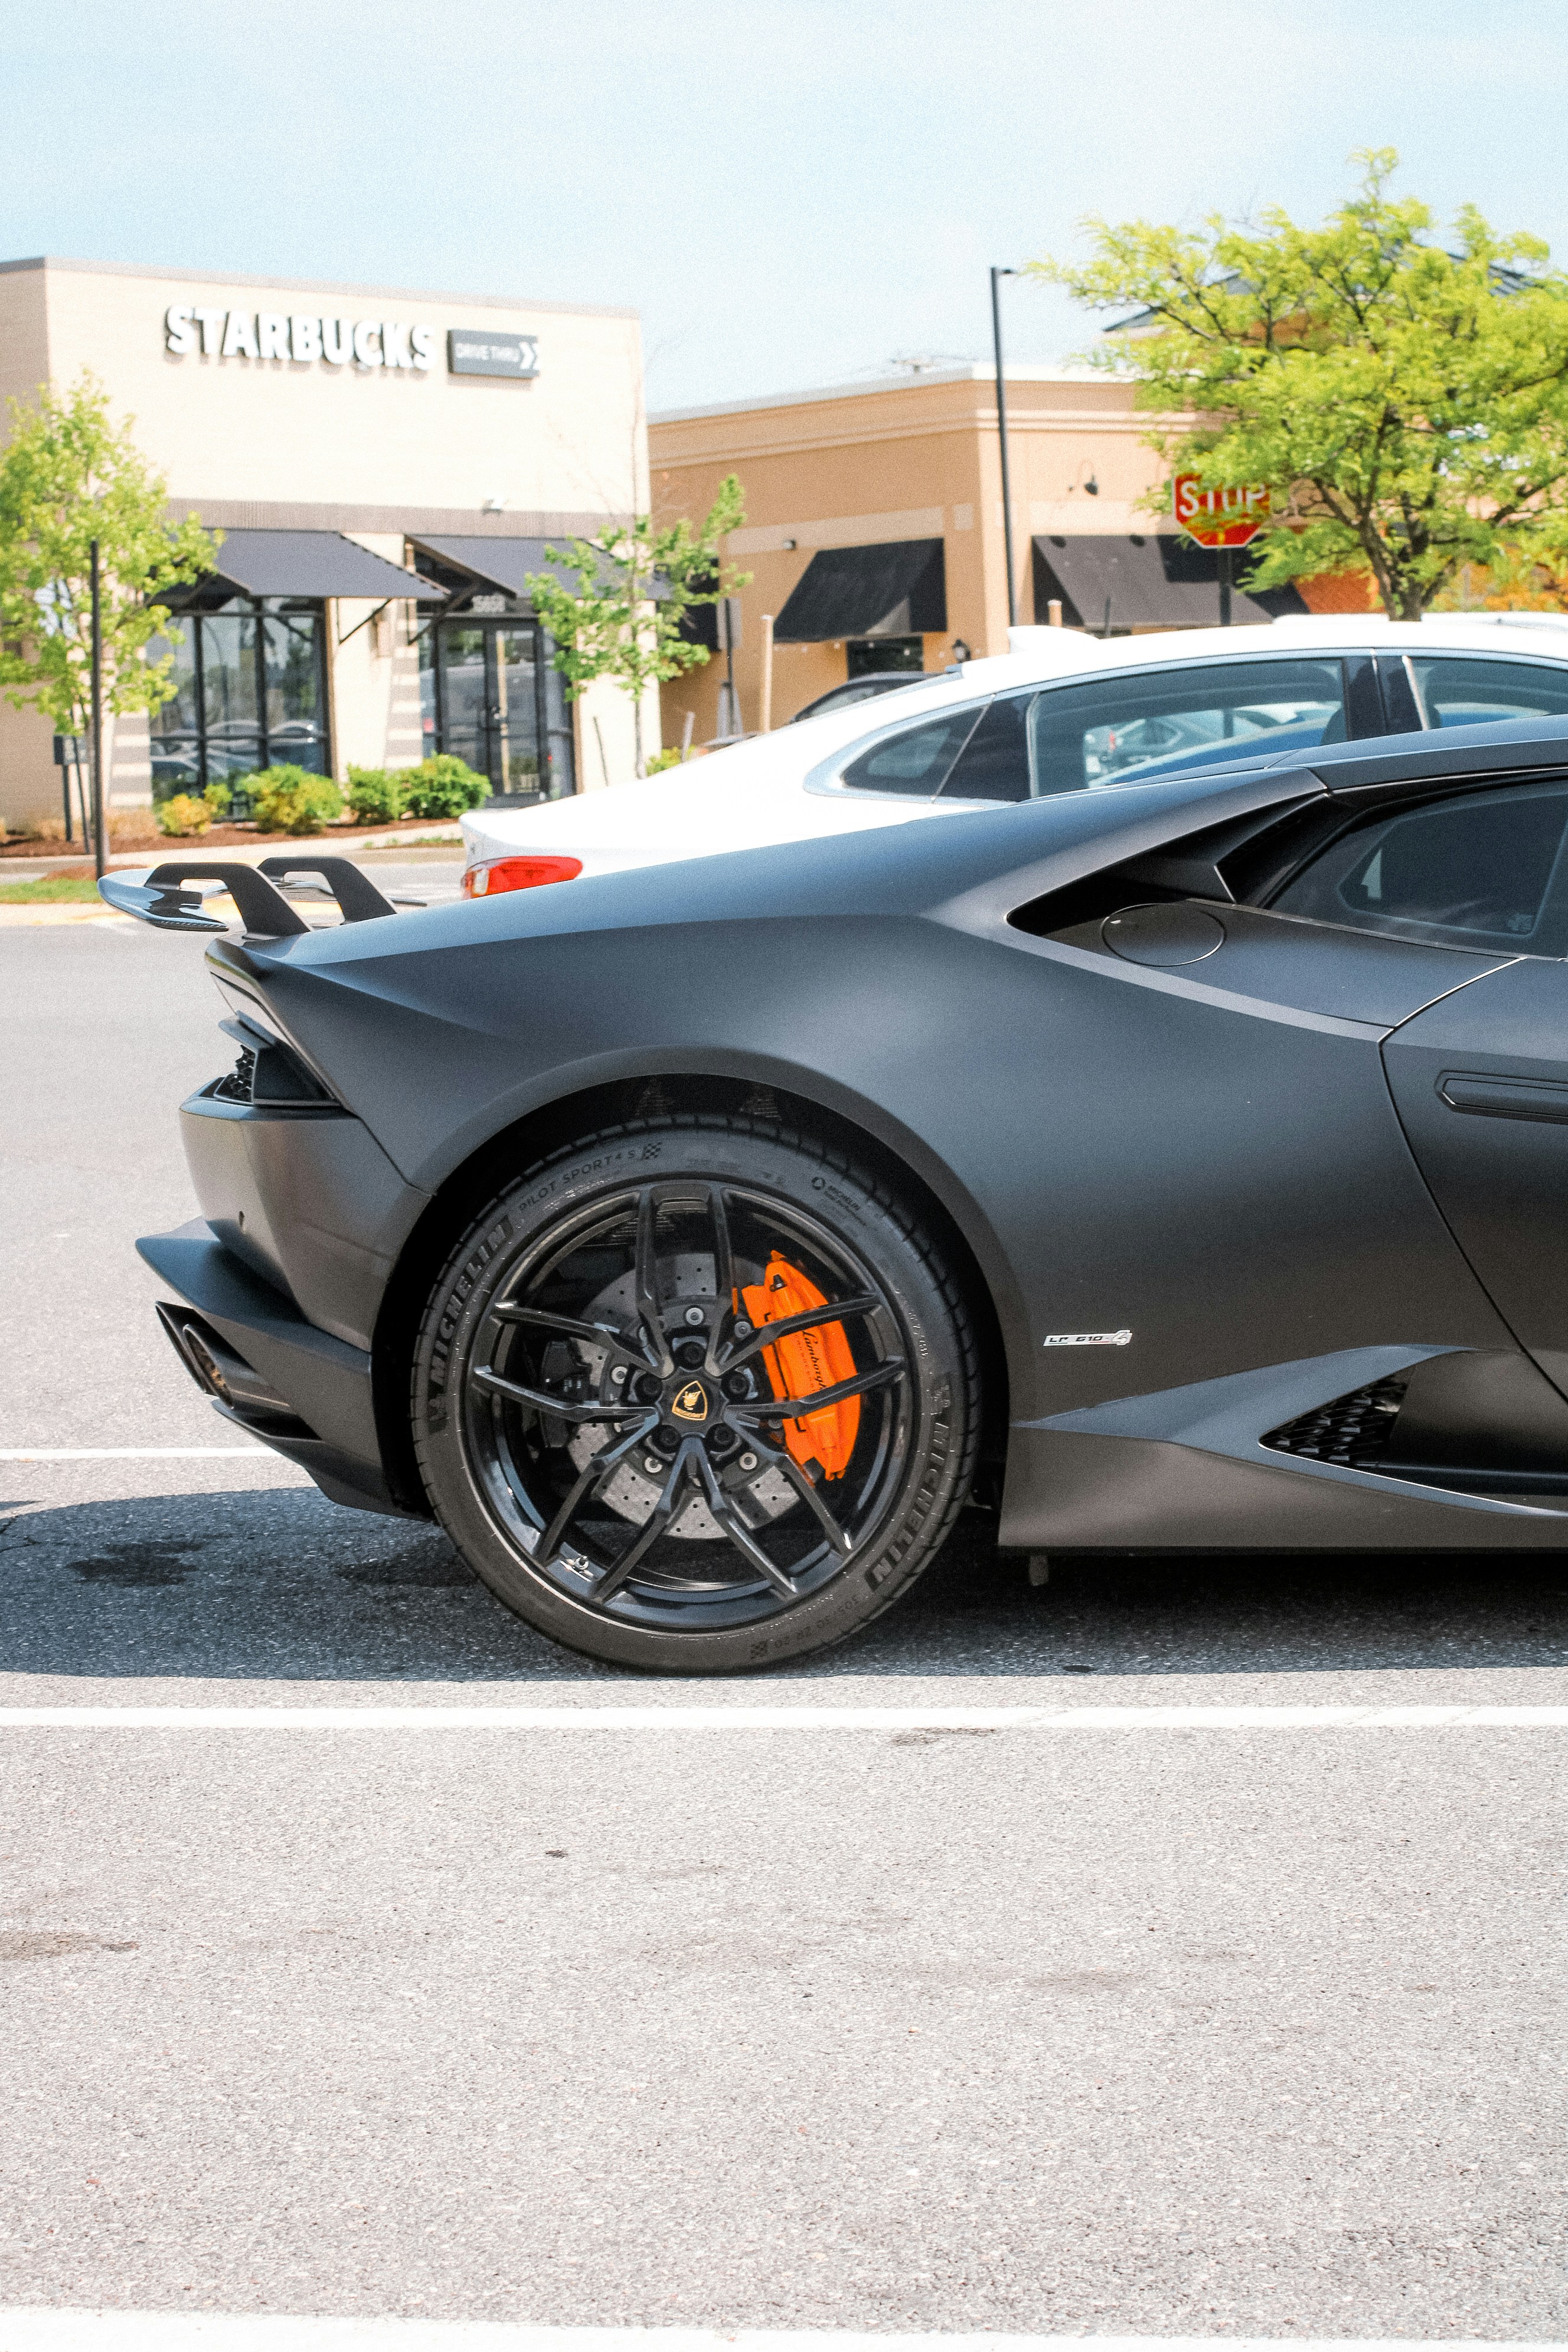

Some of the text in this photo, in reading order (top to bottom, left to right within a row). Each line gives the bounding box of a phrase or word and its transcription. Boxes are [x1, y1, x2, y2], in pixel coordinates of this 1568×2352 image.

[166, 303, 435, 371] STARBUCKS
[518, 1180, 557, 1211] PILOT
[430, 1224, 508, 1385] MICHELIN
[872, 1422, 949, 1583] MICHELIN
